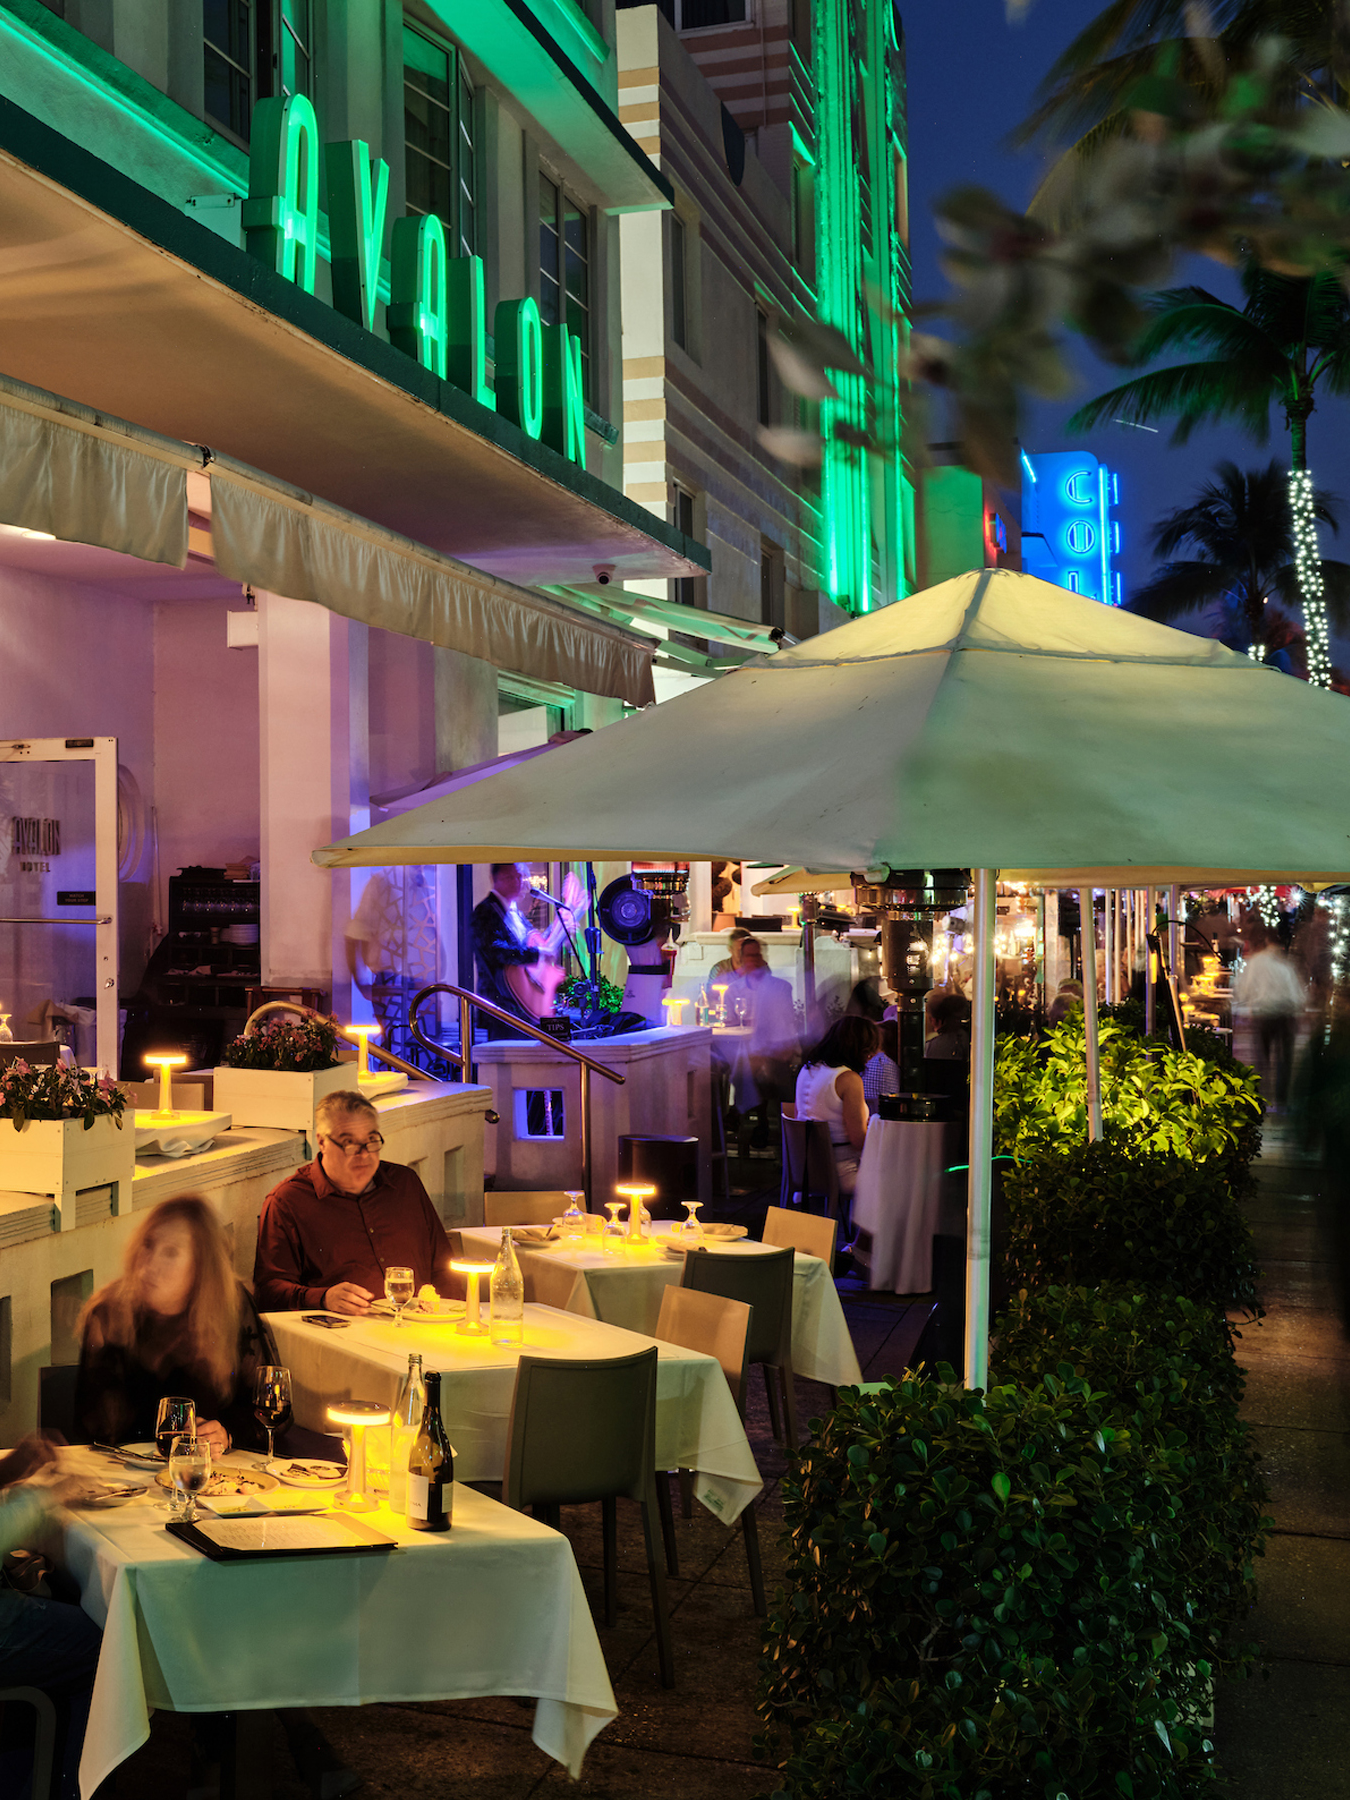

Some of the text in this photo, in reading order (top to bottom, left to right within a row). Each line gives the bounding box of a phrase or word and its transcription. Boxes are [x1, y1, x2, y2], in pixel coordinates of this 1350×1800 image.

[250, 93, 587, 471] AVALON
[11, 816, 61, 856] AVALON
[20, 862, 51, 873] HOTEL
